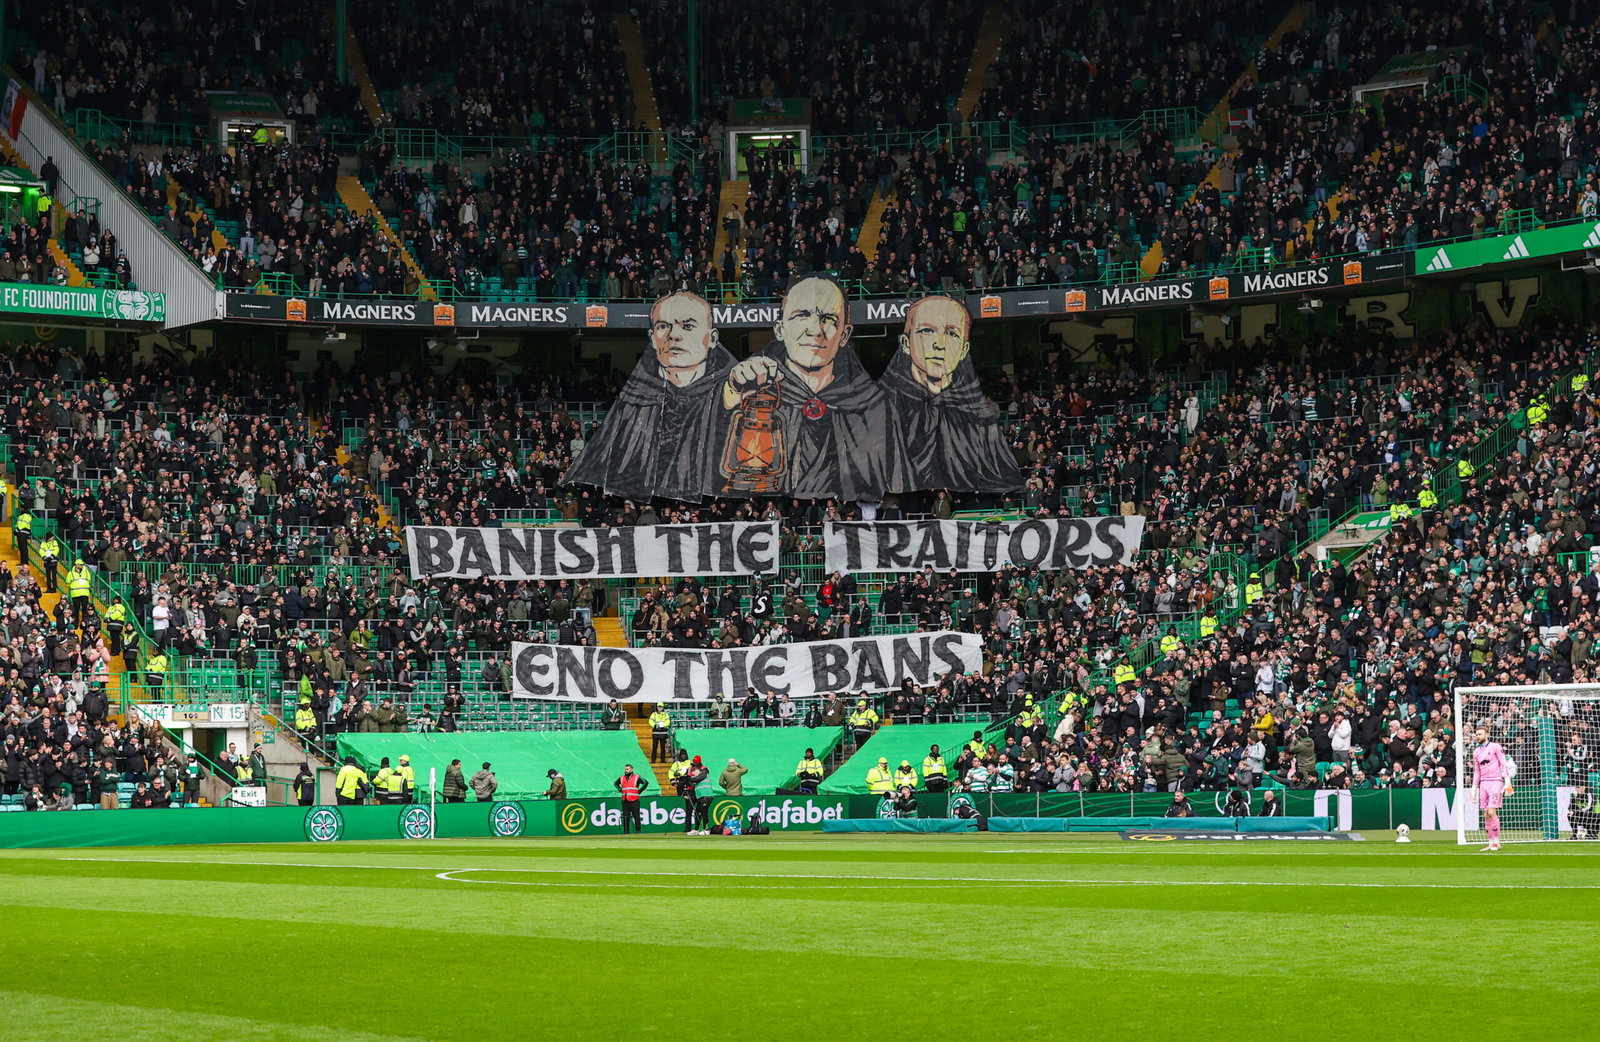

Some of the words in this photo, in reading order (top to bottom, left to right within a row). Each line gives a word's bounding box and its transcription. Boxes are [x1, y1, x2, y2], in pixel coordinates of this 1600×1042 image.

[1243, 266, 1330, 293] MAGNERS
[5, 288, 19, 307] FC
[23, 289, 96, 312] FOUNDATION
[1102, 282, 1194, 306] MAGNERS
[323, 302, 417, 320] MAGNERS
[472, 305, 569, 323] MAGNERS
[713, 307, 781, 325] MAGNE
[412, 527, 638, 576] BANISH
[655, 524, 774, 573] THE
[832, 516, 1126, 570] TRAITORS
[663, 647, 791, 699] THE
[808, 634, 965, 692] BANS
[230, 707, 241, 719] 15
[591, 801, 695, 827] daabe
[747, 799, 844, 828] dafabet
